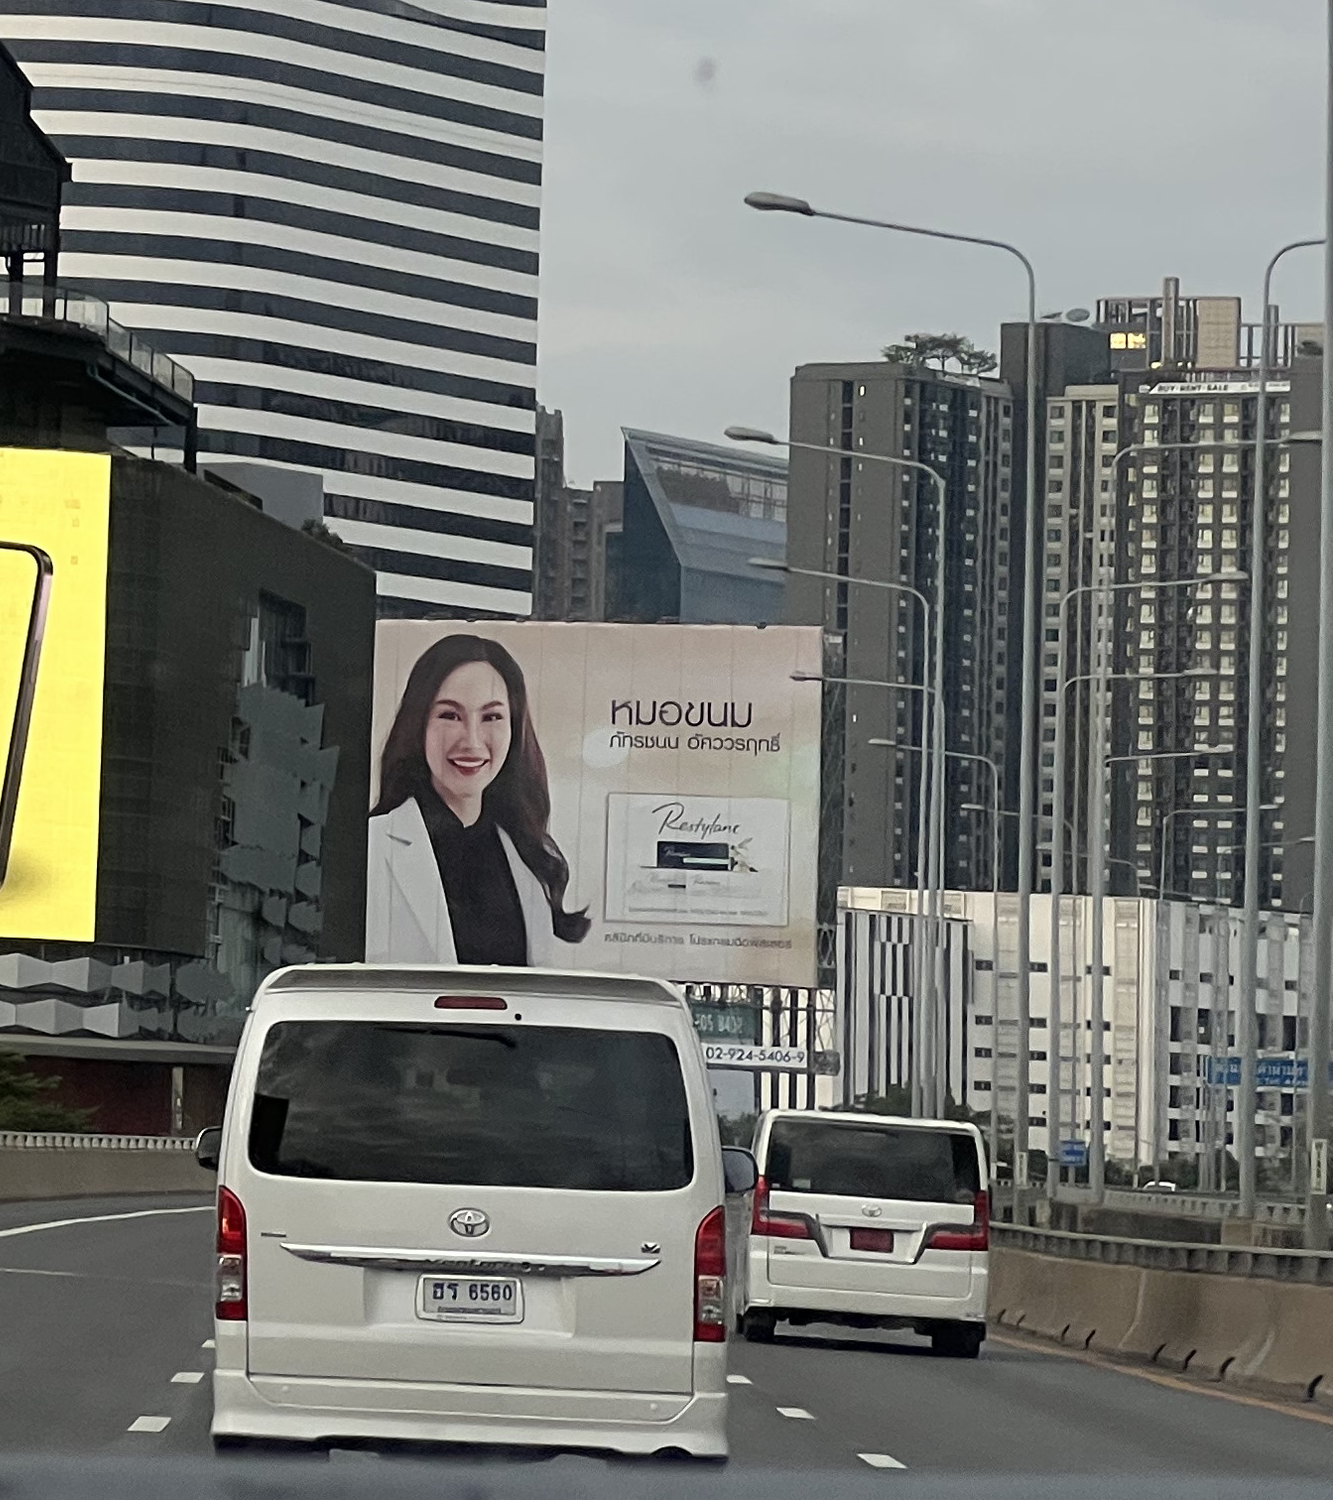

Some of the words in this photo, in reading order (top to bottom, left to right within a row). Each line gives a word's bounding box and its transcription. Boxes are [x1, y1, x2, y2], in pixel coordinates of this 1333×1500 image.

[611, 700, 753, 728] หมอขนม
[652, 802, 741, 840] Restylane
[705, 1046, 805, 1063] 02-924-5406-9
[468, 1283, 513, 1301] 6560
